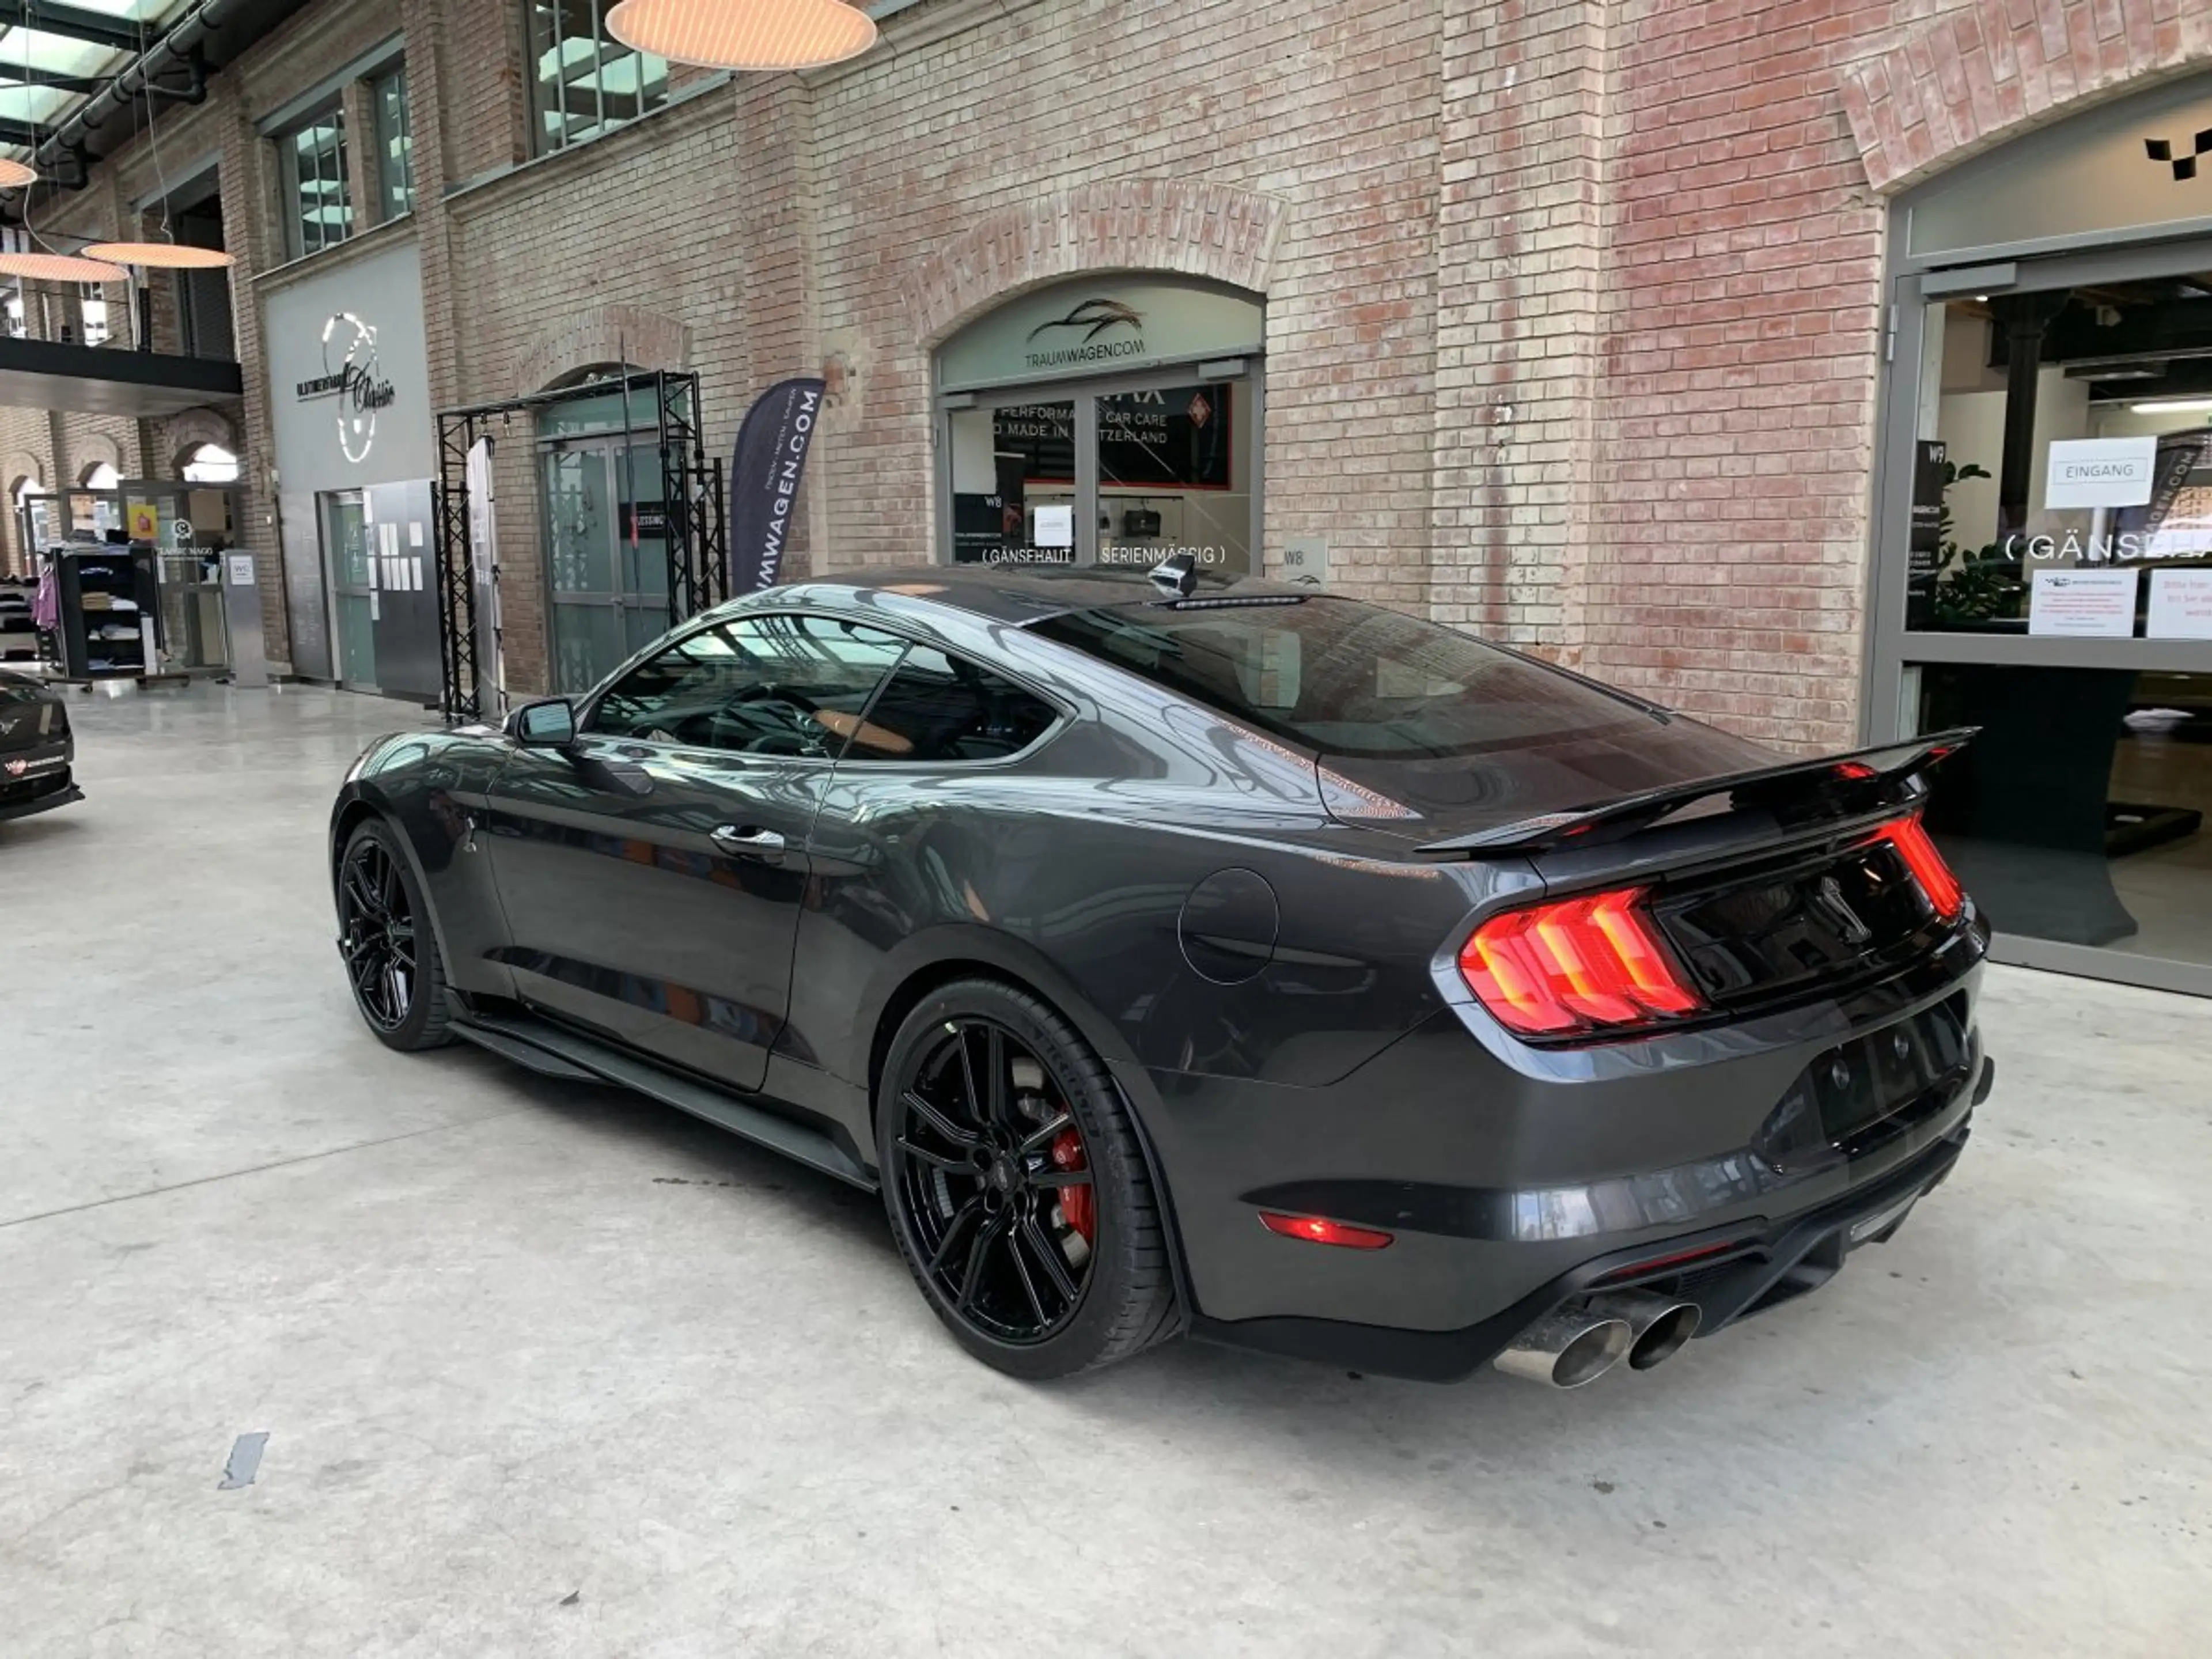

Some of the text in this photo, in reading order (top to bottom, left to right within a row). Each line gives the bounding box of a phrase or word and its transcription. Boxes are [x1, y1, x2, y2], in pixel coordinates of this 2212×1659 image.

[1135, 412, 1167, 427] CARE
[1008, 423, 1048, 437] MADE
[1054, 427, 1069, 437] IN
[2066, 464, 2134, 479] EINGANG
[984, 496, 1002, 508] W8
[1284, 550, 1304, 566] W8
